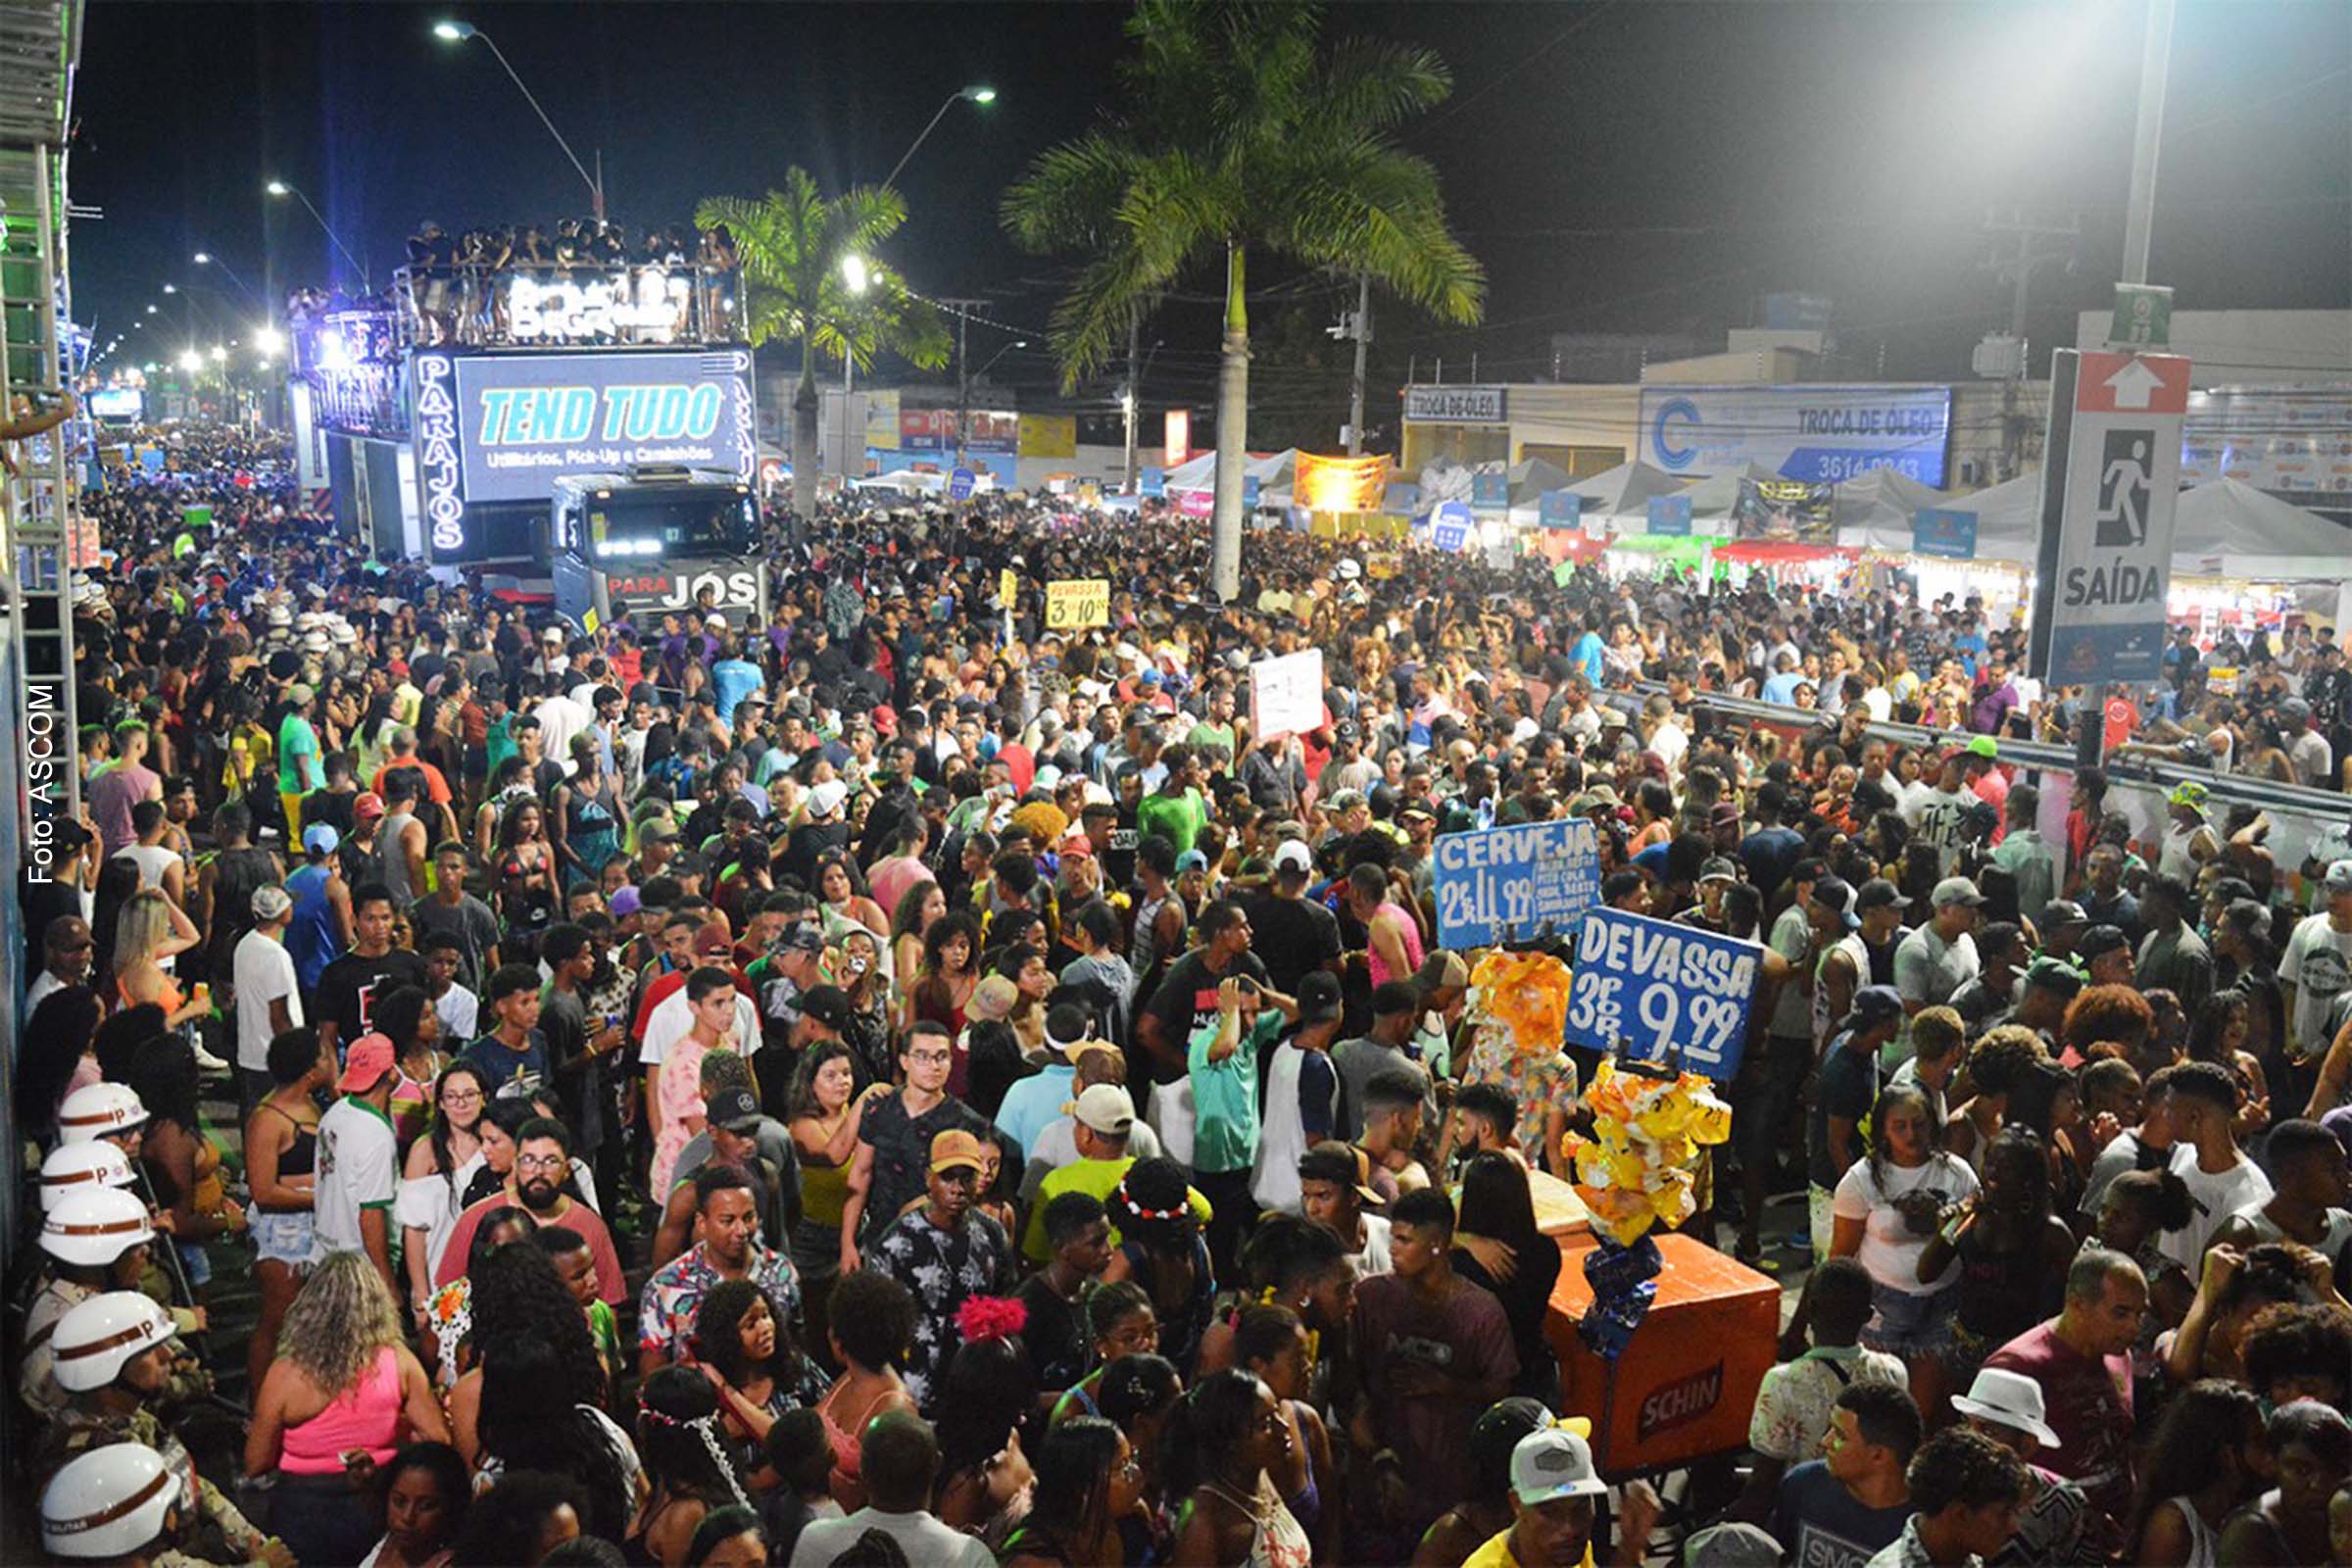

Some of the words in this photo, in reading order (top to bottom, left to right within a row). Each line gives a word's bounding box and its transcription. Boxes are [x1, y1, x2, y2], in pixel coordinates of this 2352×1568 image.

[479, 387, 597, 446] TEND
[602, 382, 725, 441] TUDO
[1798, 410, 1853, 434] TROCA
[1858, 410, 1882, 434] DE
[417, 357, 465, 549] PARAJOS
[566, 450, 620, 466] Pick-Up
[608, 576, 671, 596] PARA
[2064, 557, 2161, 606] SAÍDA
[1051, 599, 1066, 623] 3
[1441, 823, 1596, 870] CERVEJA
[1581, 915, 1755, 999] DEVASSA
[1569, 972, 1599, 1029] 3
[1641, 1373, 1719, 1428] SCHIN
